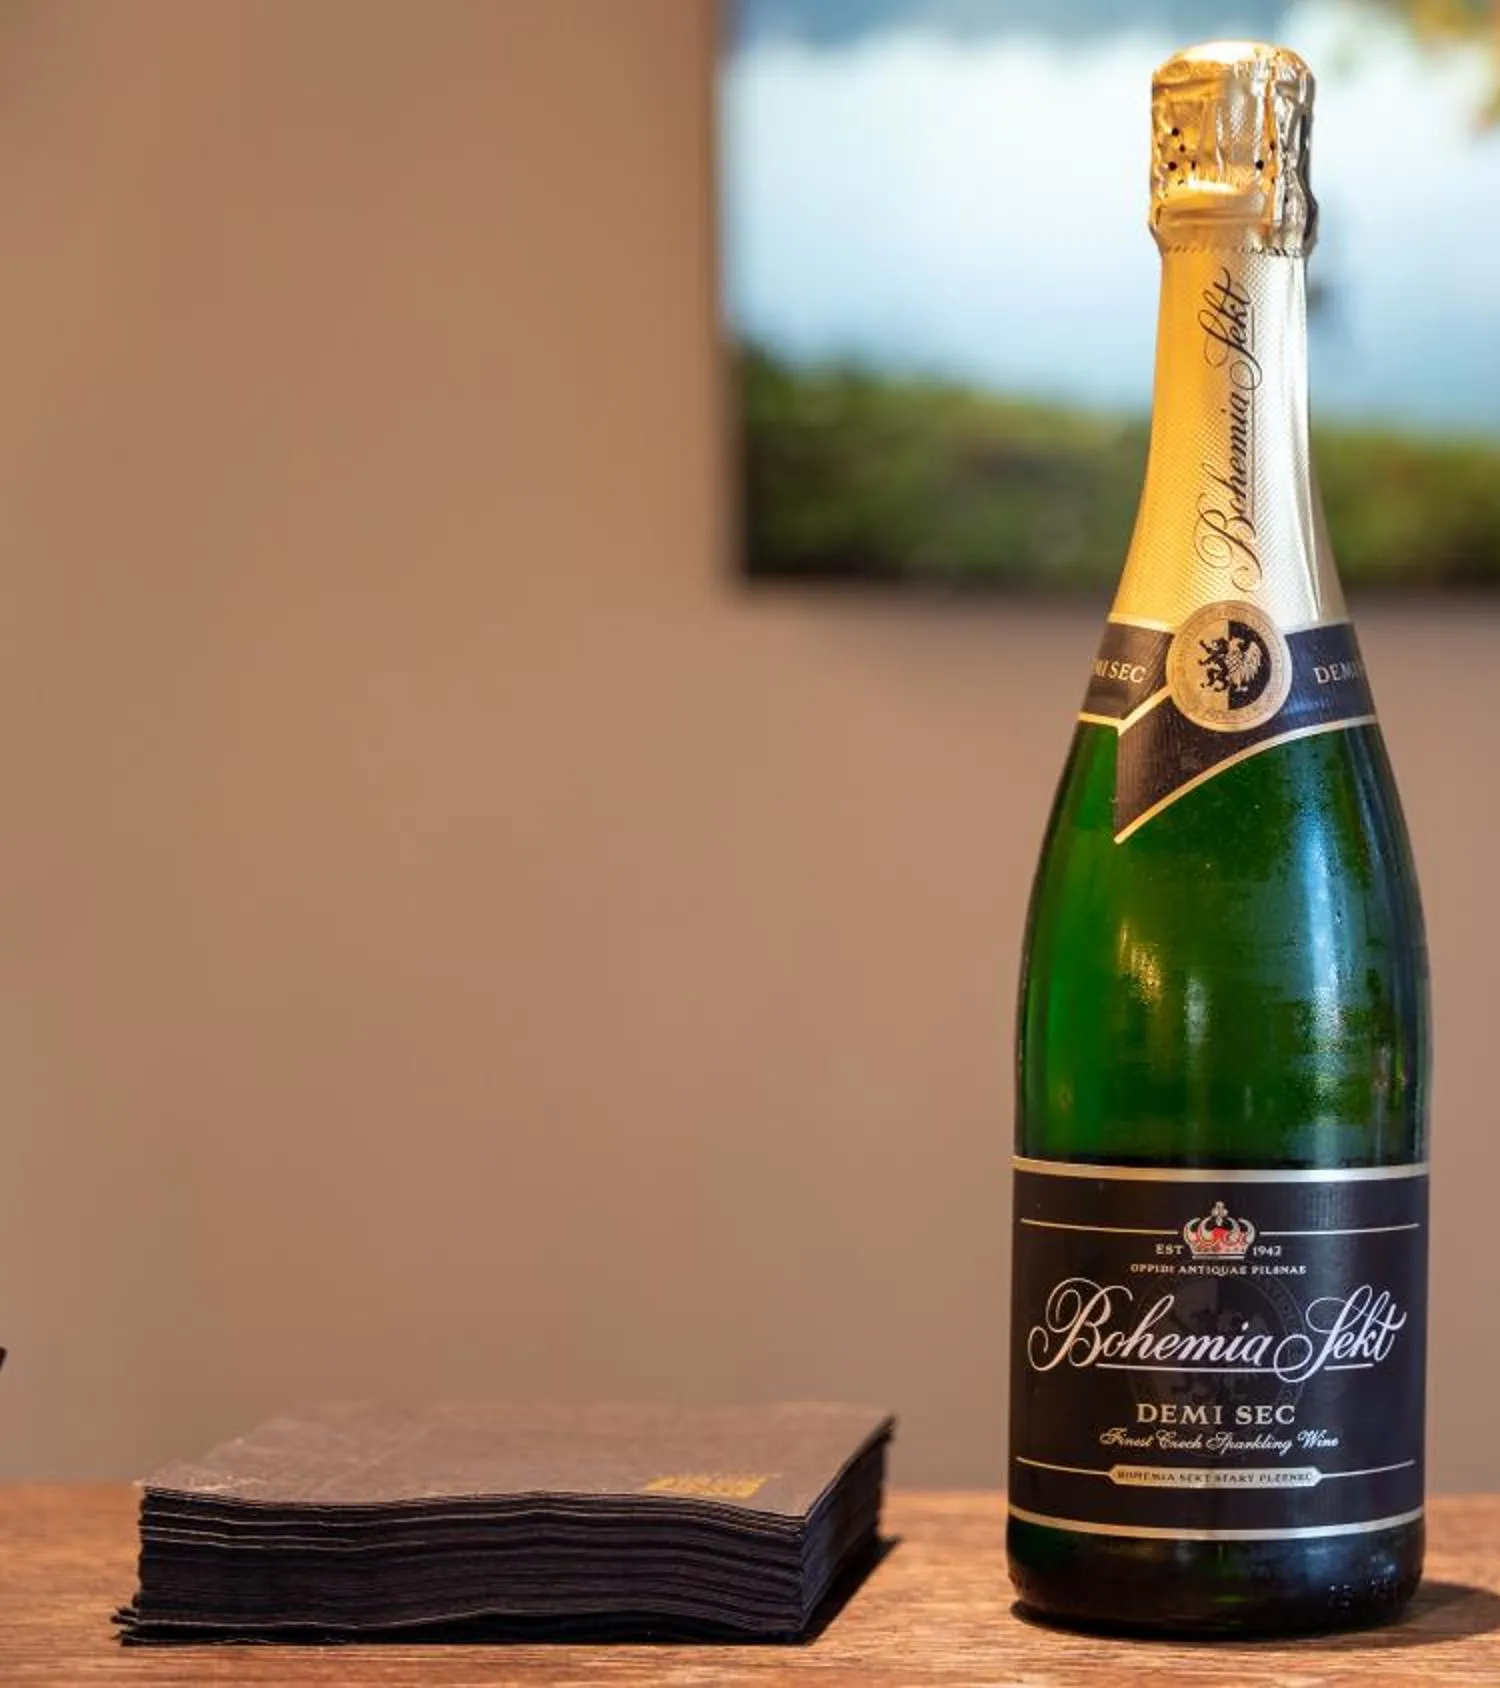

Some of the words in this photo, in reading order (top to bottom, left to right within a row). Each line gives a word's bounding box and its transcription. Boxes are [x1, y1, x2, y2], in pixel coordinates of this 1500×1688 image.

[1197, 266, 1262, 391] Sekt
[1193, 391, 1262, 592] Bohemia
[1108, 661, 1146, 683] SEC
[1155, 1244, 1184, 1255] EST
[1253, 1245, 1282, 1256] 1942
[1178, 1265, 1247, 1276] ANTIQUAE
[1027, 1276, 1274, 1372] Bohemia
[1273, 1284, 1407, 1383] Sekt
[1136, 1403, 1223, 1424] DEMI
[1235, 1405, 1296, 1424] SEC
[1100, 1427, 1153, 1447] Finest
[1155, 1429, 1201, 1449] Czech
[1206, 1431, 1293, 1456] Sparkling
[1297, 1430, 1339, 1447] Wine
